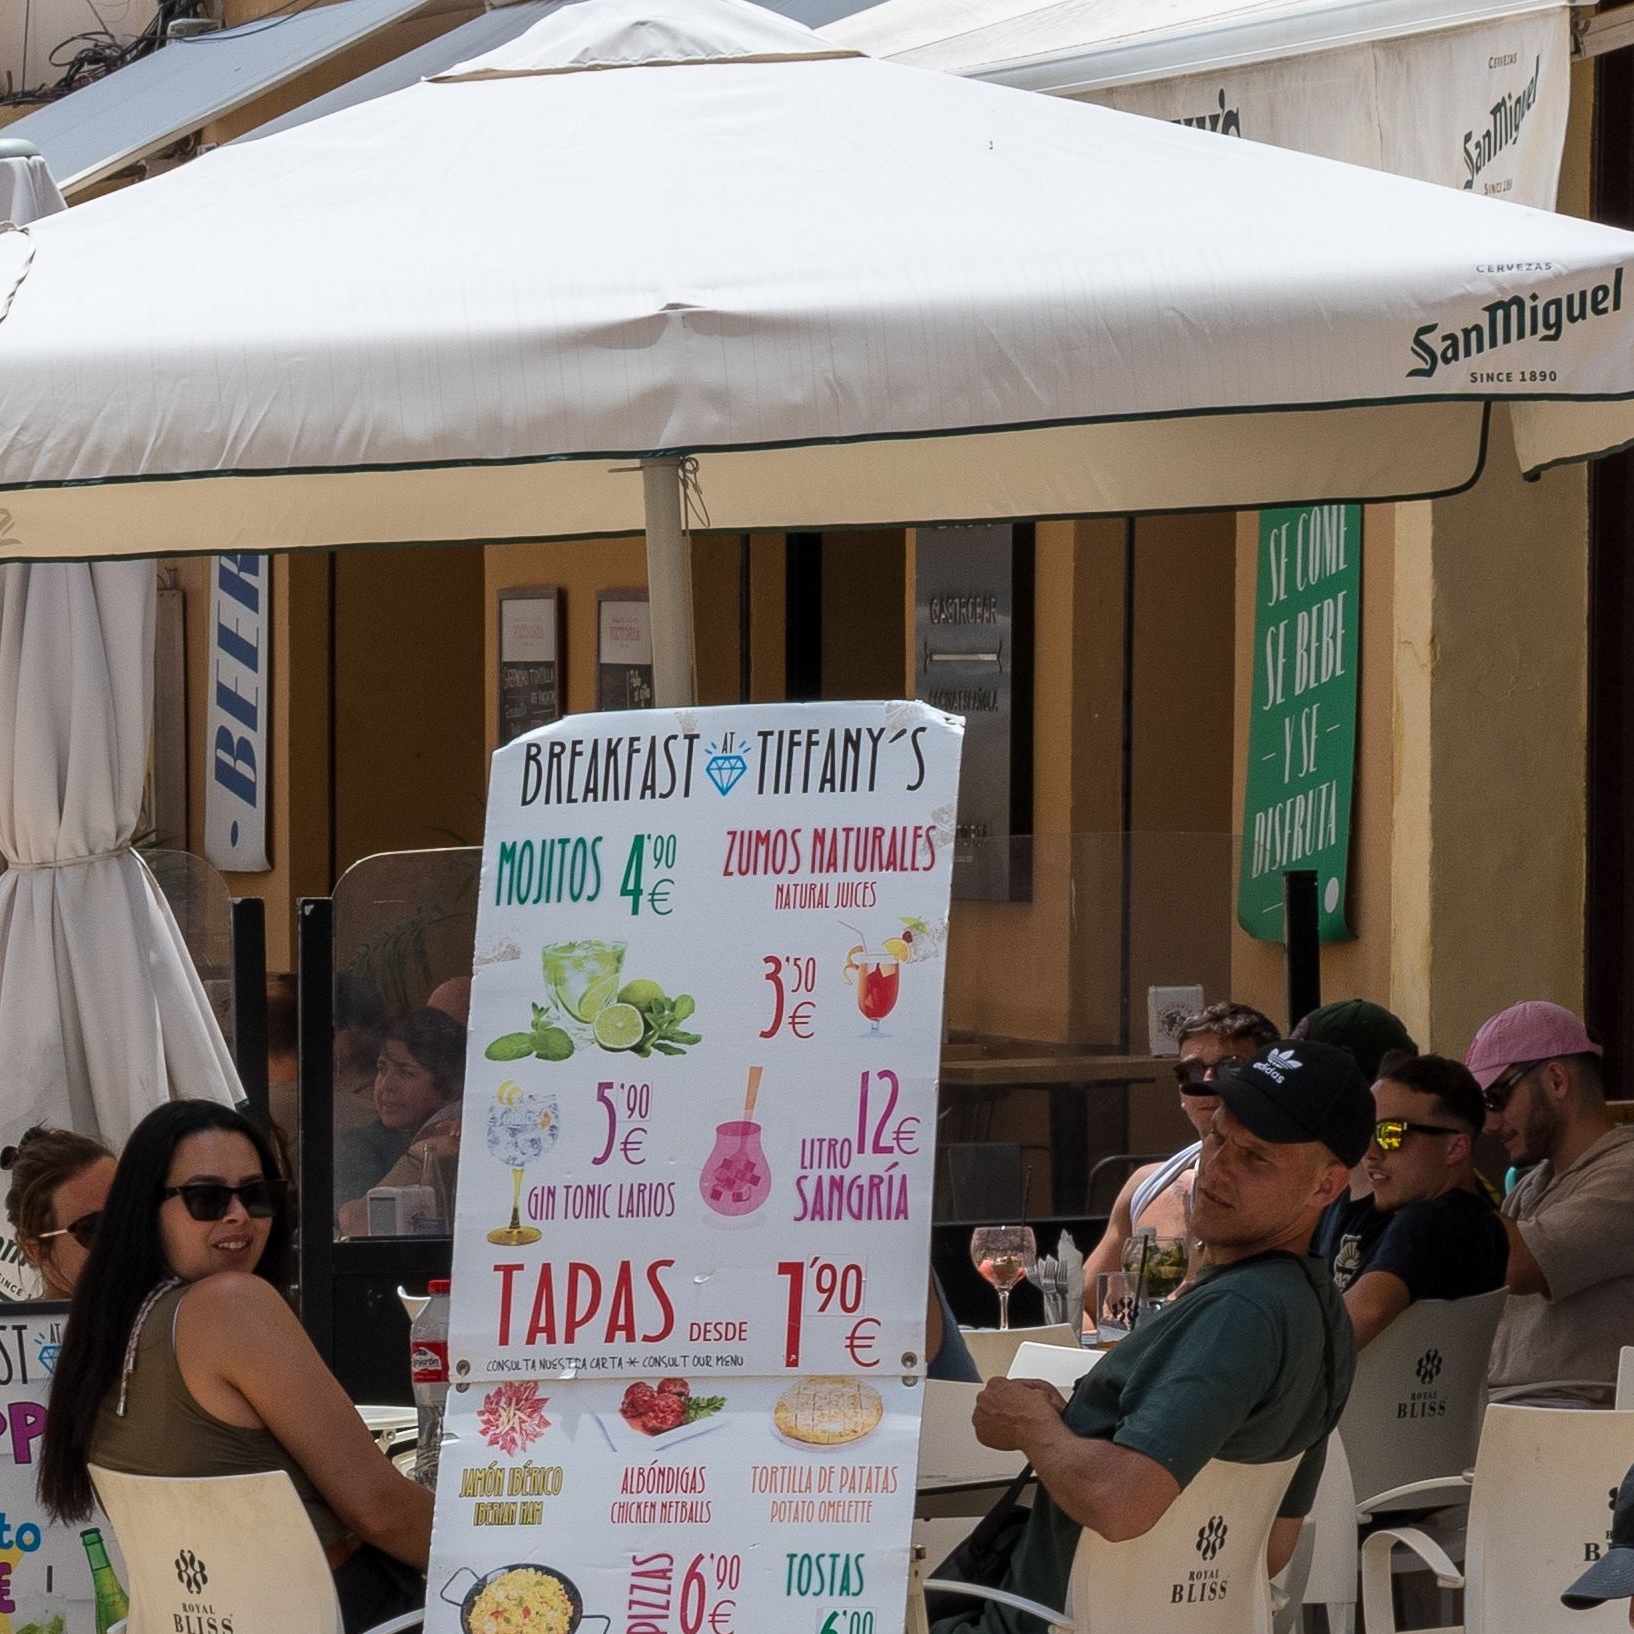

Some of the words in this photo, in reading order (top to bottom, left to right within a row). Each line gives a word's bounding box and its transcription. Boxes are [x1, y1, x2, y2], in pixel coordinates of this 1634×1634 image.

[1476, 262, 1553, 274] CERVEZAS
[1470, 371, 1514, 384] SINCE
[1520, 370, 1557, 383] 1890
[1267, 522, 1290, 606] SE
[1263, 619, 1289, 711] SE
[1294, 590, 1347, 697] BEBE
[215, 554, 259, 809] BEER
[1282, 715, 1296, 784] Y
[1298, 703, 1320, 778] SE
[520, 732, 700, 806] BREAKFAST
[721, 731, 736, 754] AT
[1252, 780, 1338, 879] DISFRUTA
[722, 829, 803, 877] ZUMOS
[810, 825, 937, 872] NATURALES
[495, 834, 603, 906] MOJITOS
[775, 884, 829, 911] NATURAL
[833, 881, 878, 910] JUICES
[1252, 1062, 1285, 1085] adidas
[800, 1137, 853, 1170] LITRO
[527, 1187, 560, 1221] GIN
[563, 1185, 612, 1220] TONIC
[616, 1182, 677, 1219] LARIOS
[793, 1162, 909, 1222] SANGRÍA
[493, 1259, 676, 1346] TAPAS
[688, 1321, 748, 1342] DESDE
[486, 1358, 536, 1372] CONSULTA
[589, 1356, 623, 1370] CARTA
[642, 1355, 688, 1369] CONSULT
[692, 1354, 713, 1367] OUR
[716, 1354, 744, 1367] MENU
[1396, 1400, 1447, 1420] BLISS
[1410, 1391, 1438, 1402] ROYAL
[459, 1460, 505, 1498] JAMÓN
[507, 1459, 564, 1496] IBÉRICO
[620, 1459, 706, 1495] ALBÓNDIGAS
[750, 1465, 813, 1494] TORTILLA
[816, 1465, 836, 1493] DE
[837, 1465, 899, 1494] PATATAS
[473, 1501, 517, 1526] IBERIAN
[518, 1501, 543, 1525] HAM
[610, 1501, 657, 1524] CHICKEN
[770, 1501, 816, 1523] POTATO
[818, 1499, 873, 1523] OMELETTE
[785, 1553, 865, 1597] TOSTAS
[1170, 1578, 1228, 1605] BLISS
[1187, 1569, 1220, 1581] ROYAL
[182, 1602, 215, 1615] ROYAL
